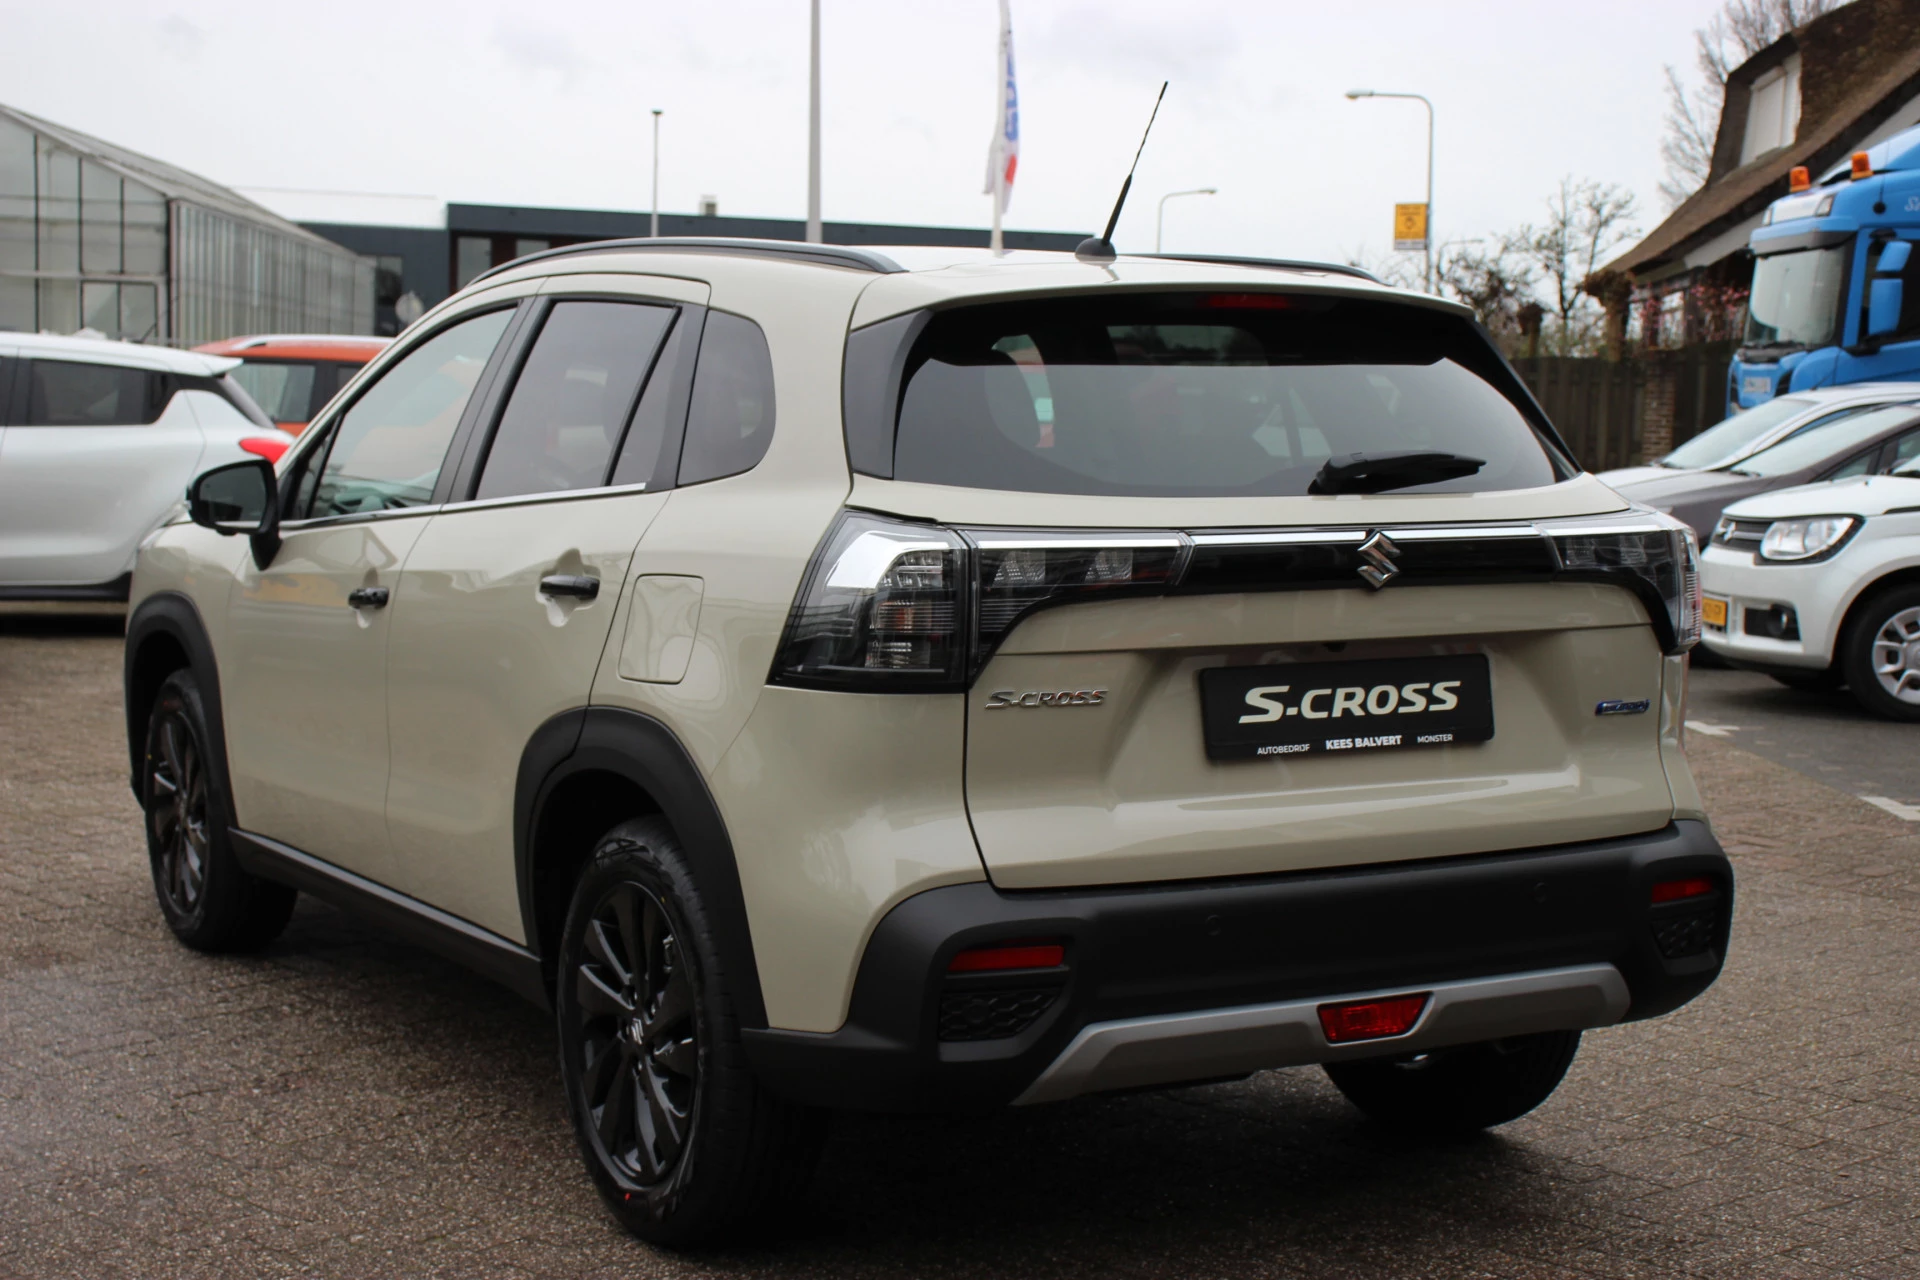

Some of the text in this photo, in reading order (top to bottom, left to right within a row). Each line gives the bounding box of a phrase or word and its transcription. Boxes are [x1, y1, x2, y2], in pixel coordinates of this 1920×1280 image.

[985, 689, 1109, 709] S-CROSS
[1238, 681, 1461, 724] S-CROSS
[1326, 738, 1354, 750] KEES
[1355, 735, 1402, 748] BALVERT
[1417, 734, 1453, 743] MONSTER
